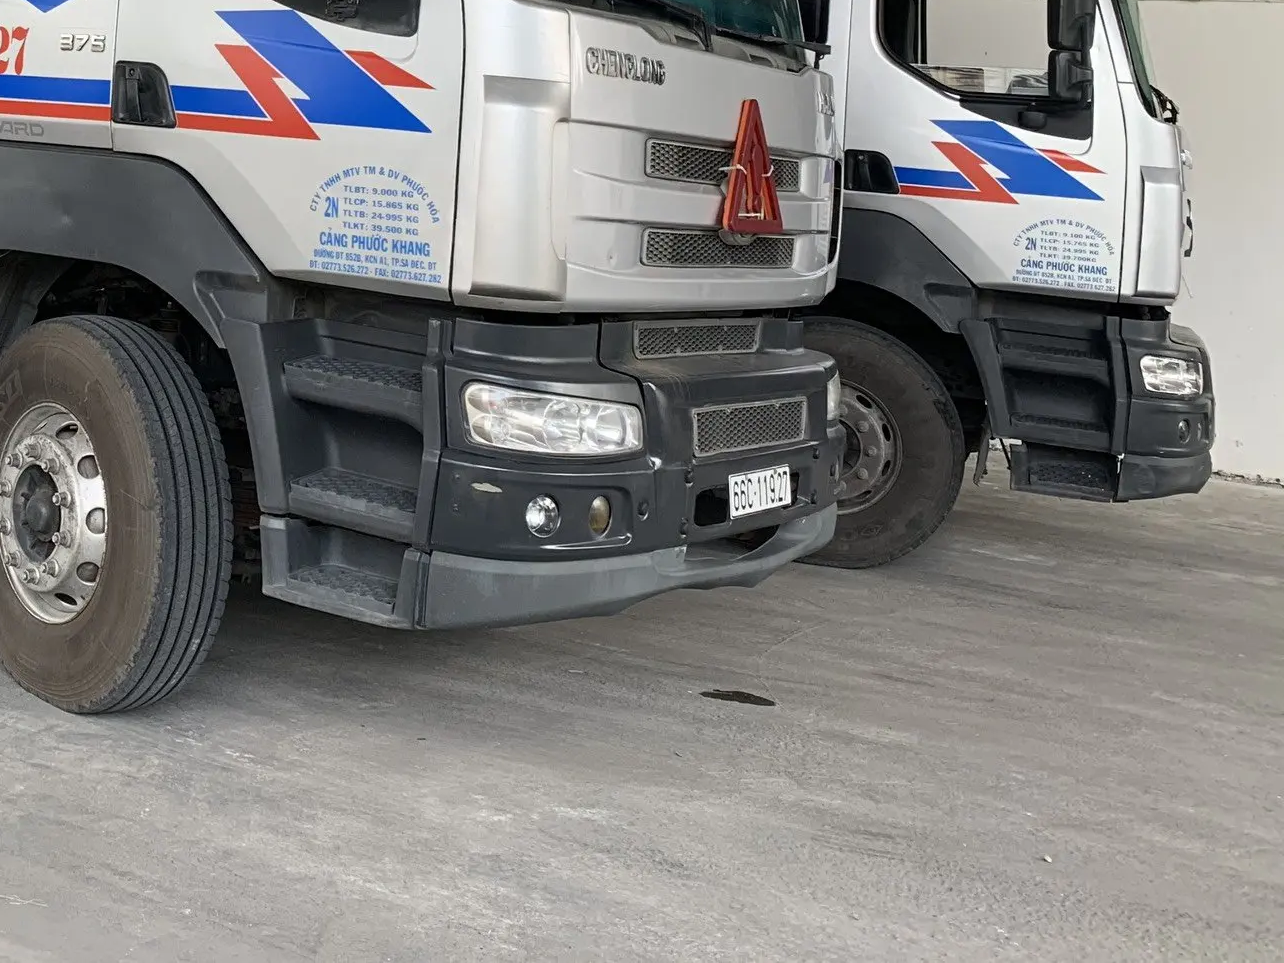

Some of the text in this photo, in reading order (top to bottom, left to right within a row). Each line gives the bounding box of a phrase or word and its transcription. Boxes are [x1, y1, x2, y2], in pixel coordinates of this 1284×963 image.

[59, 33, 106, 53] 375
[585, 46, 666, 86] CHENGLONG
[309, 192, 322, 212] CTY
[318, 173, 342, 192] TNHH
[342, 166, 361, 179] MTV
[363, 166, 376, 175] TM
[378, 166, 386, 176] &
[387, 168, 400, 180] DV
[343, 185, 414, 198] TLBT: 9.000 KG
[324, 196, 339, 218] 2N
[343, 197, 369, 207] TLCP:
[406, 203, 419, 211] KG
[343, 209, 369, 219] TLTB:
[406, 215, 419, 224] KG
[405, 227, 419, 236] KG
[391, 239, 431, 257] KHANG
[1025, 236, 1037, 251] 2N
[365, 255, 378, 265] KCN
[1078, 264, 1108, 276] KHANG
[733, 470, 788, 511] 66C-119.27
